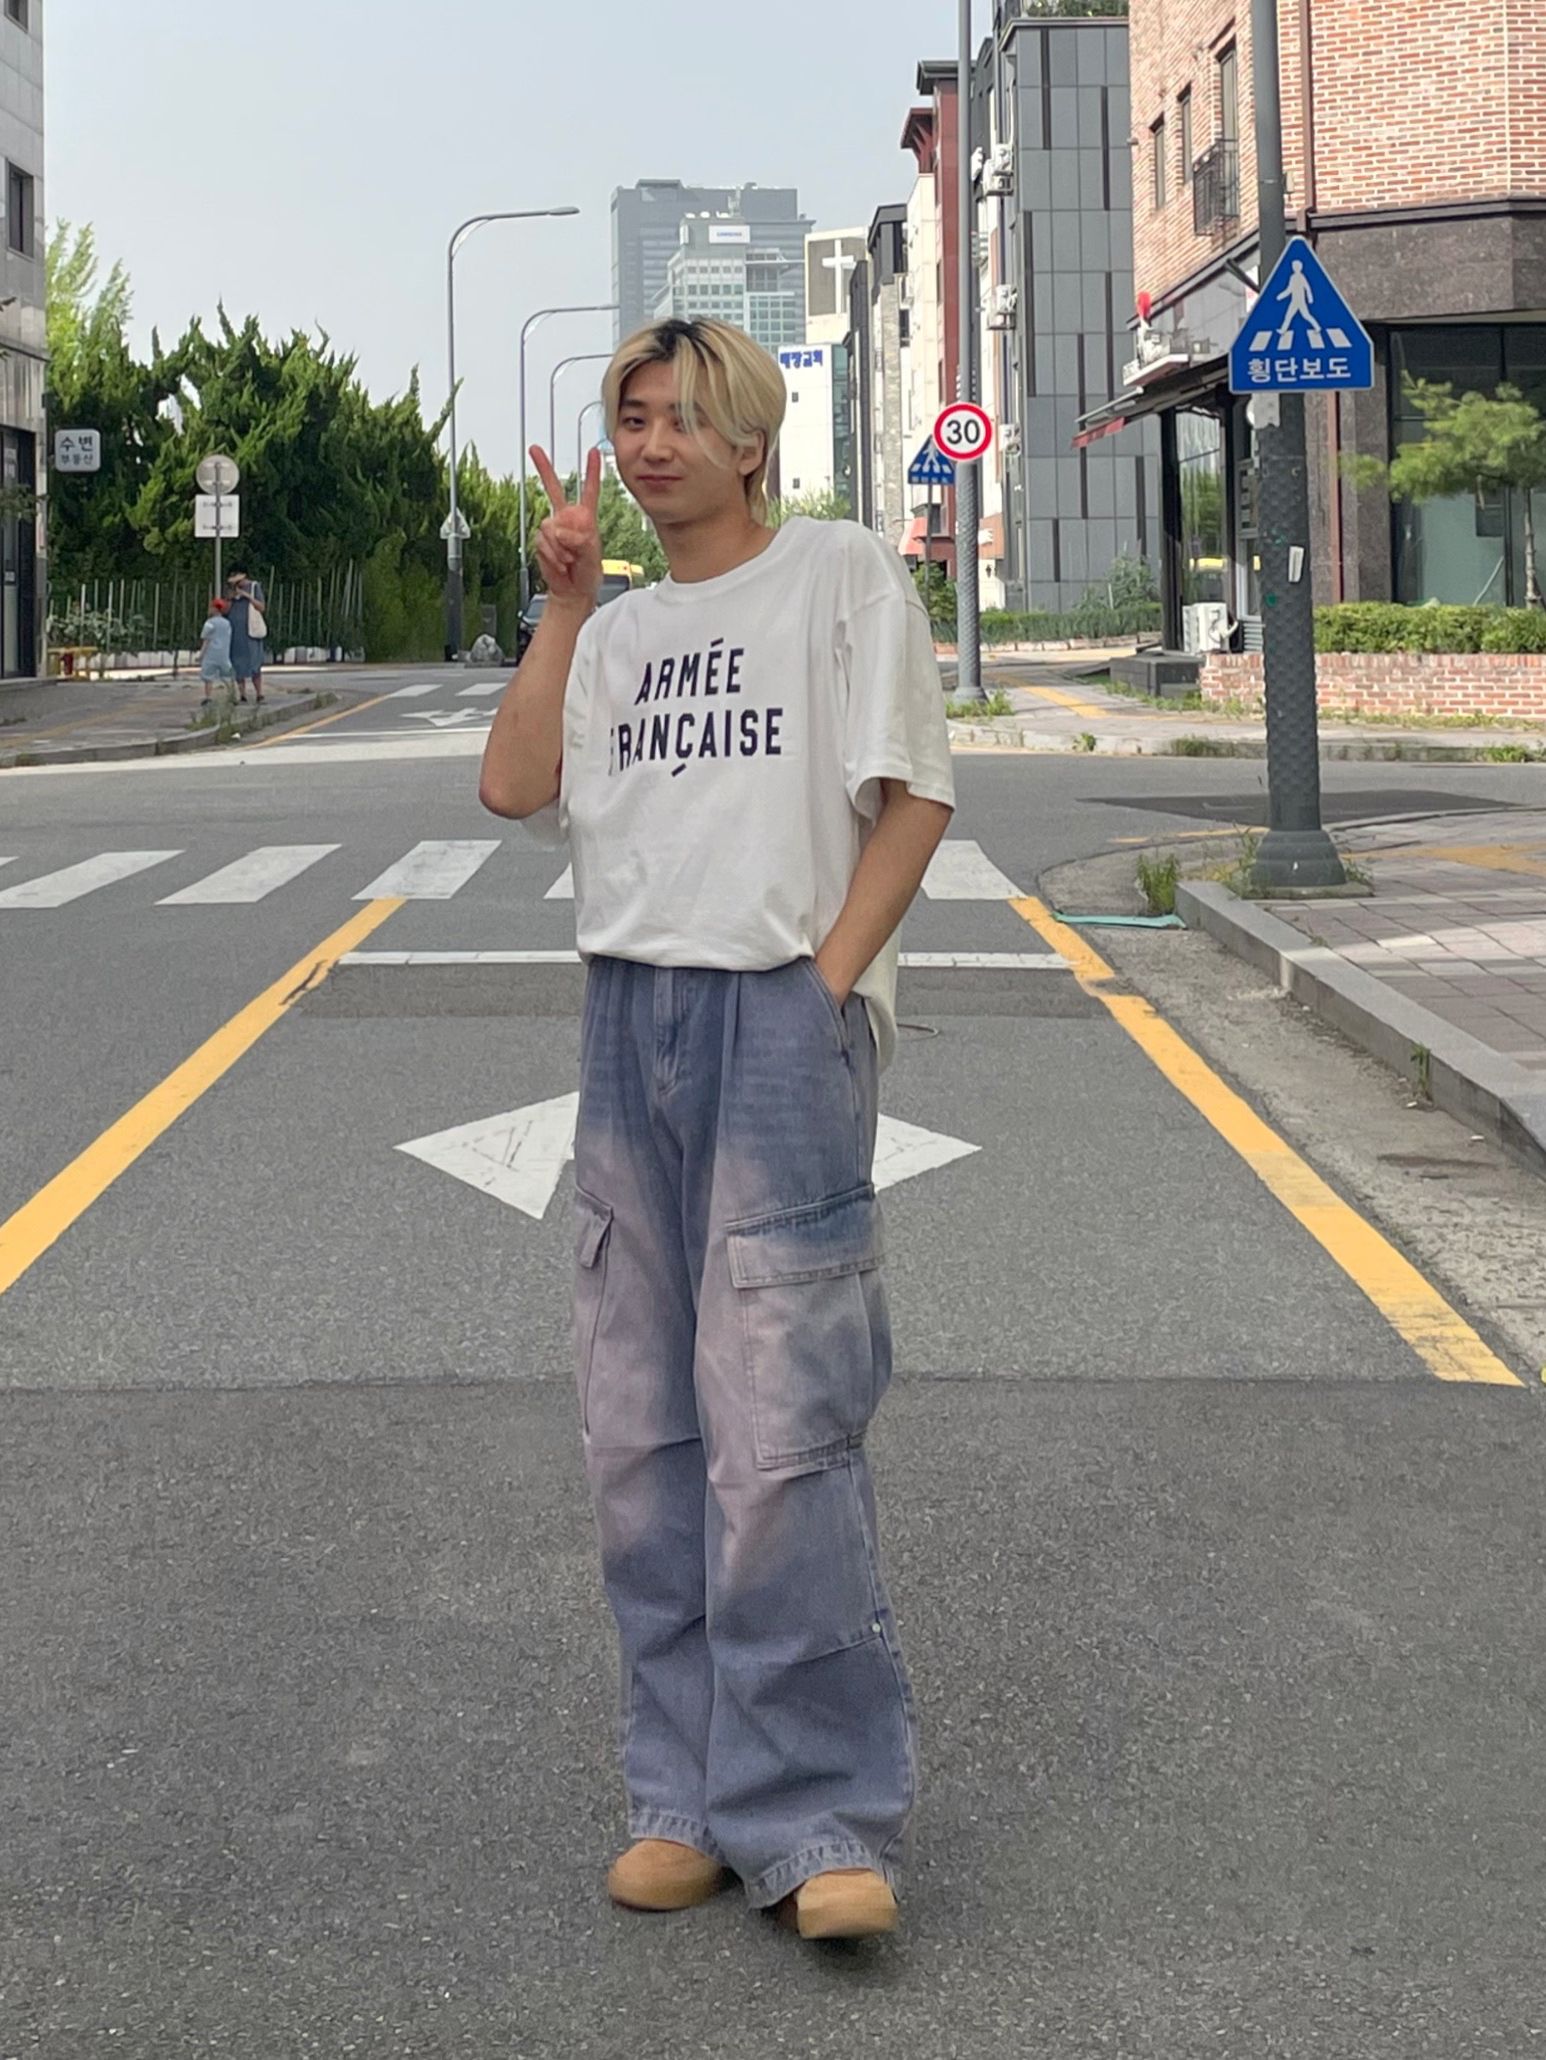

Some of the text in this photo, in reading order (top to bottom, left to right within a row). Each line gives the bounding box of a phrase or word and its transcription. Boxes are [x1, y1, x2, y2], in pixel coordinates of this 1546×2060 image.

[1248, 357, 1351, 383] 횡단보도
[60, 436, 94, 452] 수변
[947, 419, 980, 445] 30
[634, 637, 745, 706] ARMÉE
